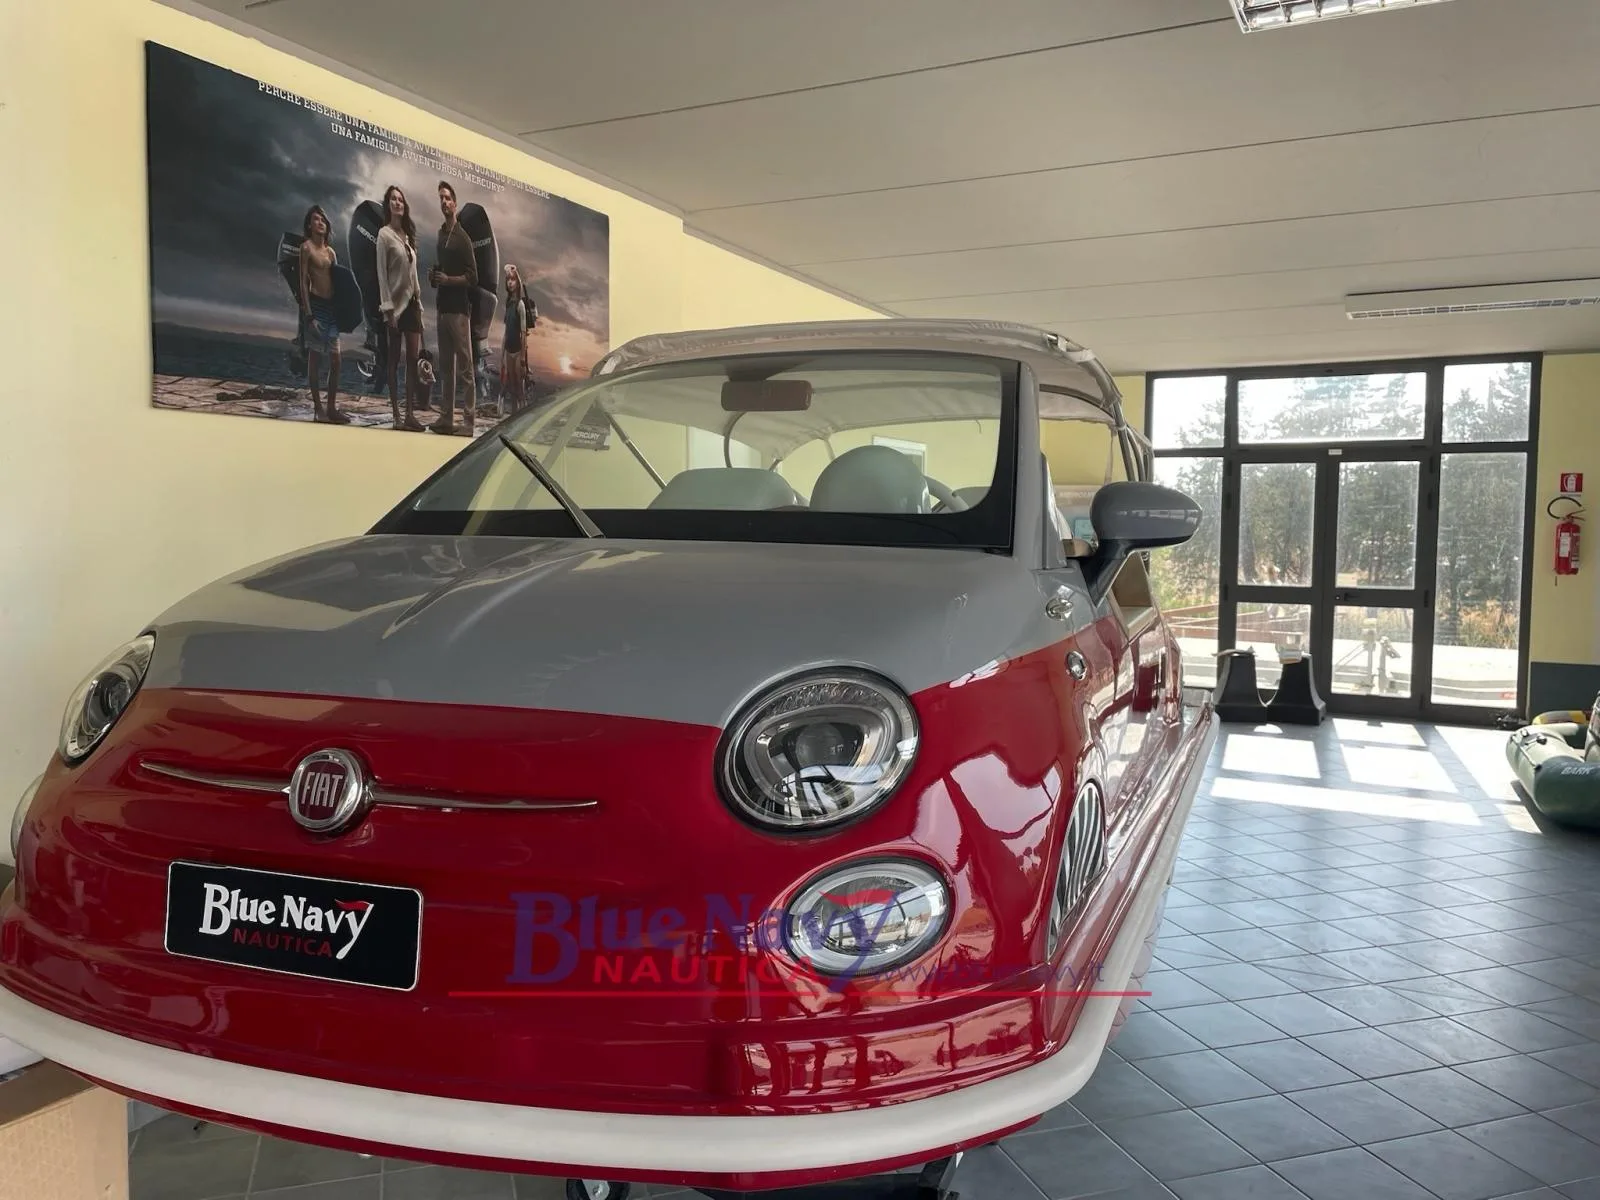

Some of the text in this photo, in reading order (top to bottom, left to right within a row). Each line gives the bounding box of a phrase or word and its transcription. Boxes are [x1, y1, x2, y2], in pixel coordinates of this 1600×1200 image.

[304, 99, 342, 121] ESSERE
[345, 114, 366, 130] UNA
[368, 122, 412, 147] FAMIGLIA
[414, 141, 473, 170] AVVENTUROSA
[474, 162, 505, 183] QUANDO
[525, 182, 550, 199] ESSERE
[331, 122, 505, 193] UNA FAMIGLIA AVVENTUROSA MERCURY?
[301, 771, 344, 808] FIAT
[199, 882, 375, 960] Blue Navy
[233, 927, 333, 958] NAUTICA
